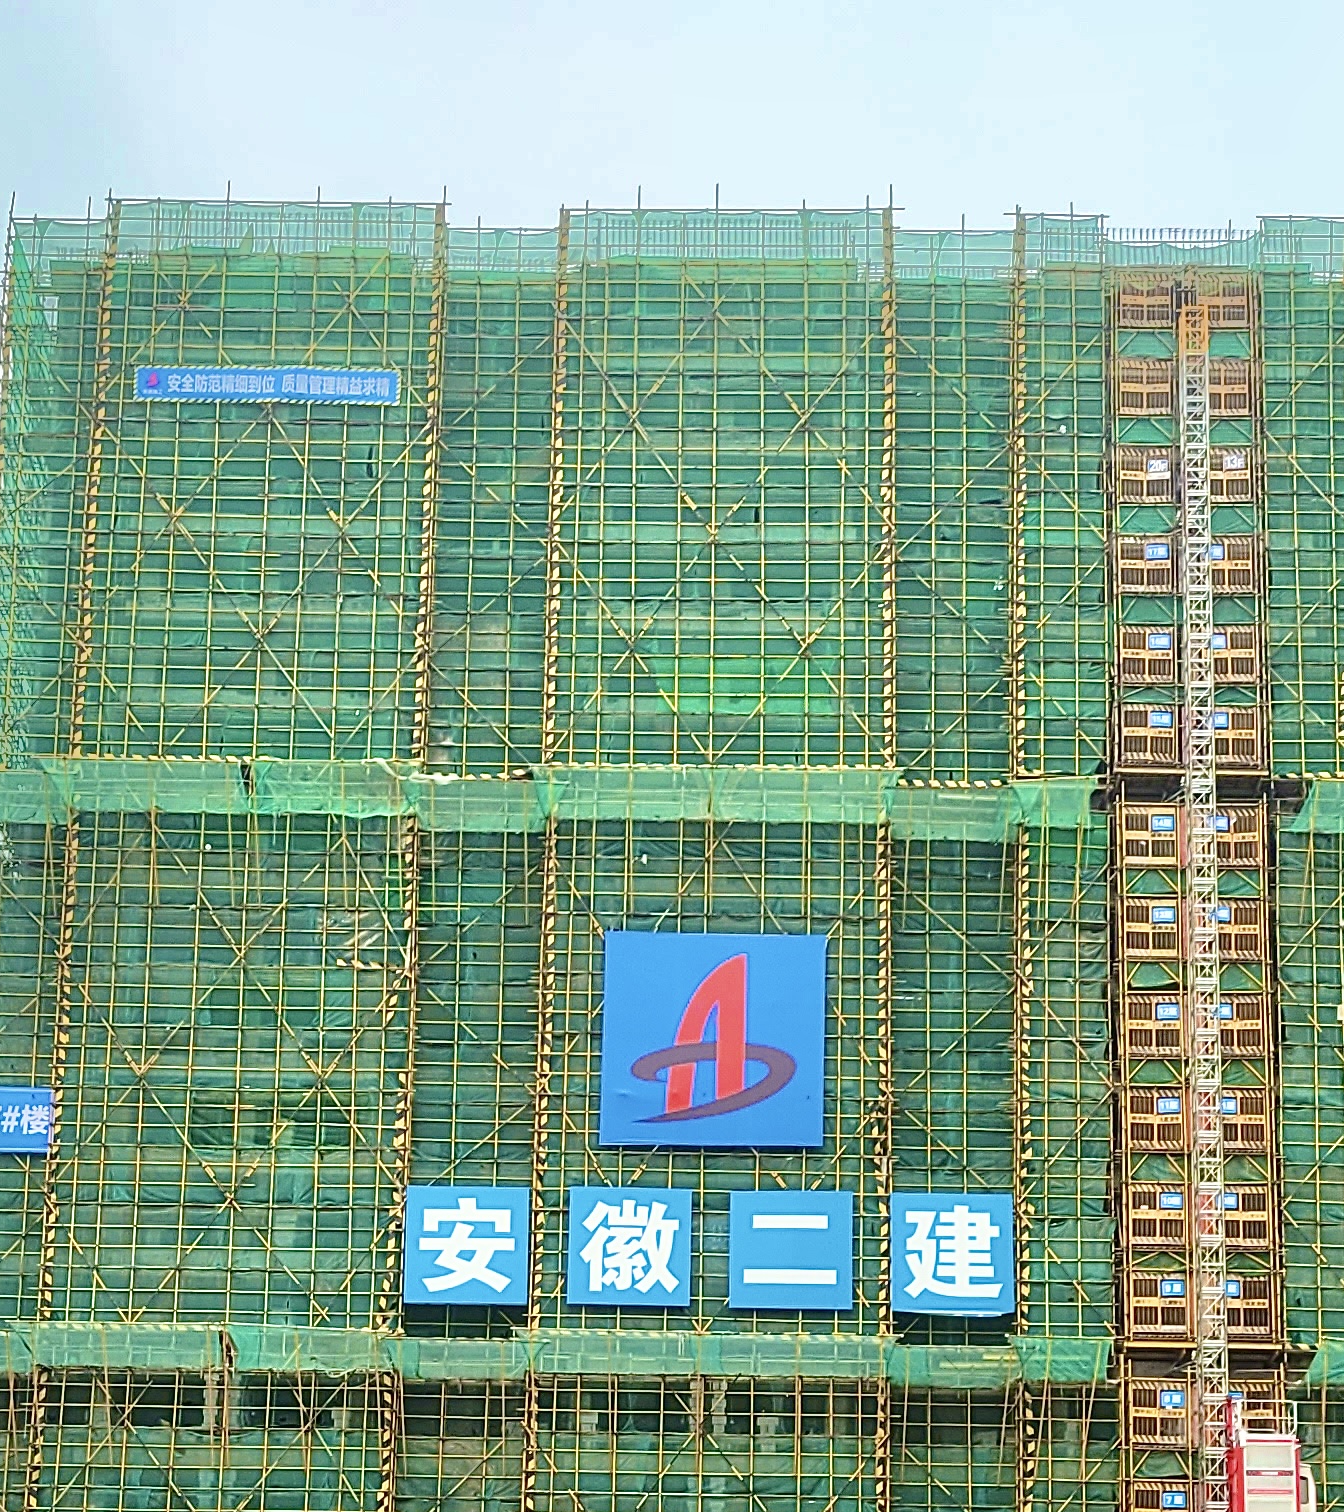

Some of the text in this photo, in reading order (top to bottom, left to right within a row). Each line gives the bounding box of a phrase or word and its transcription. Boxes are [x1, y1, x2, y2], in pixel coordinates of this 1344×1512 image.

[167, 374, 275, 395] 安全防范精细到位
[419, 1197, 1003, 1299] 安徽二建
